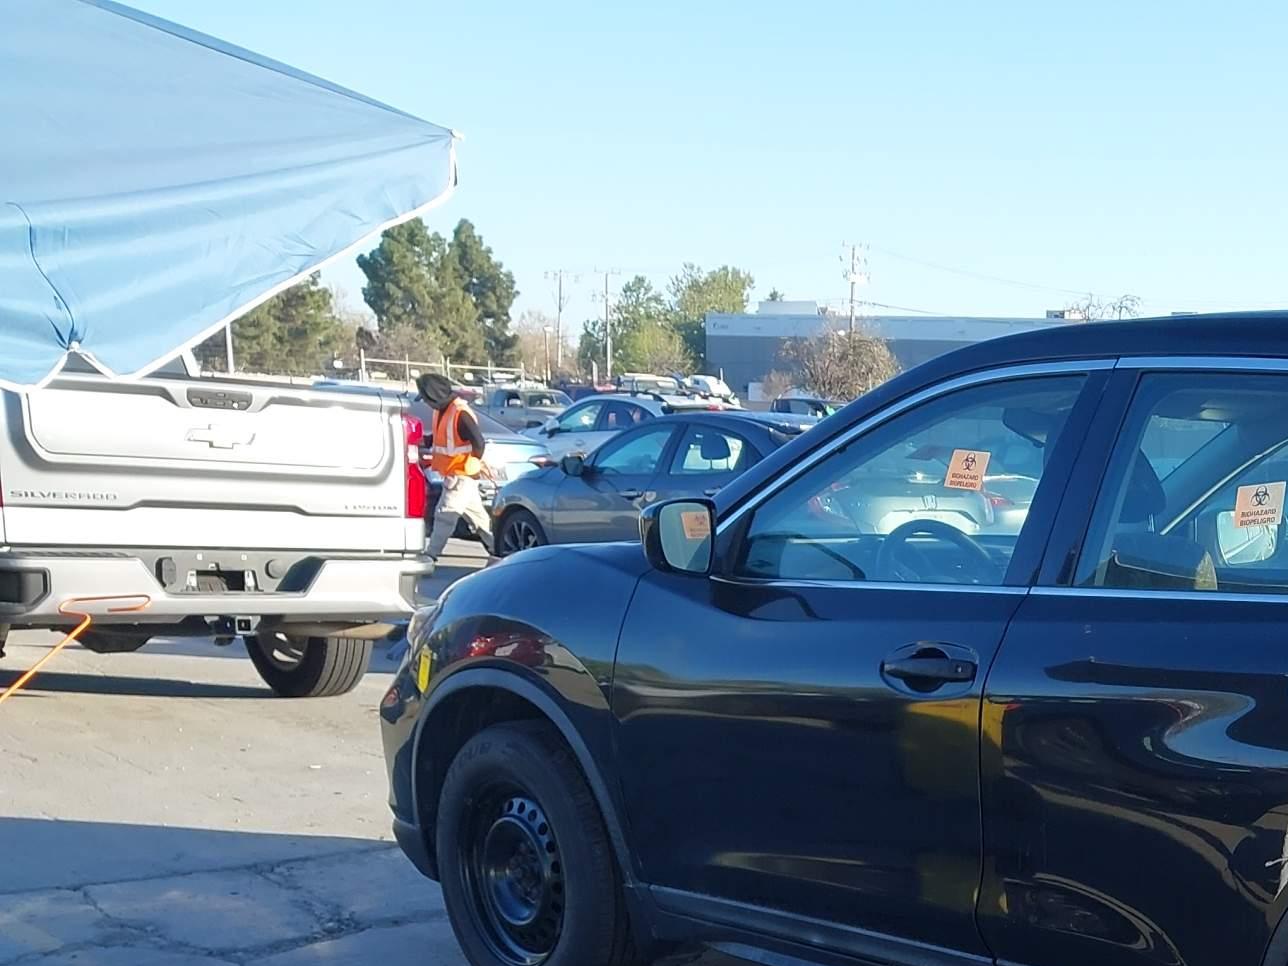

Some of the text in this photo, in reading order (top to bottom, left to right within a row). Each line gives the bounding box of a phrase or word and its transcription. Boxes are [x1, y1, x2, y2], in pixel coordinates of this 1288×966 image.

[951, 472, 979, 481] BIOHAZARD
[9, 489, 119, 502] SILVERADO
[1240, 508, 1277, 518] BIOHAZARD
[1239, 516, 1276, 527] BIOPELIGRO
